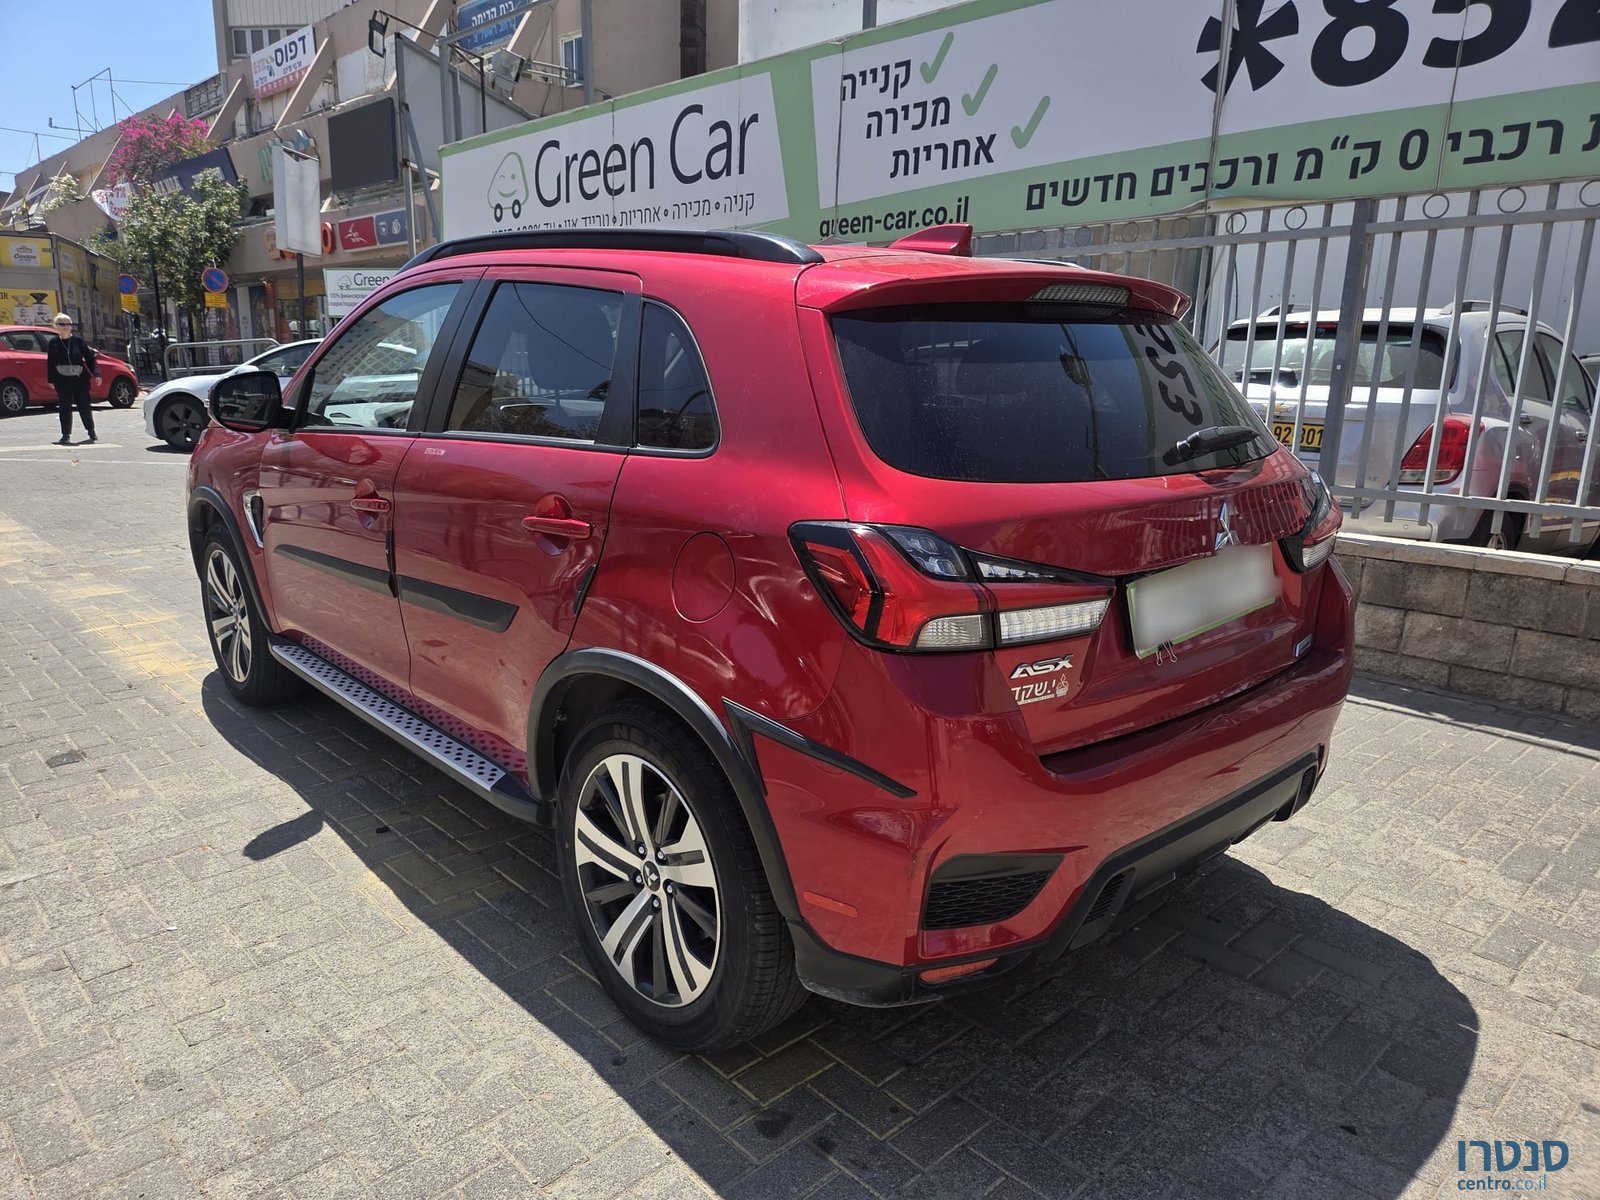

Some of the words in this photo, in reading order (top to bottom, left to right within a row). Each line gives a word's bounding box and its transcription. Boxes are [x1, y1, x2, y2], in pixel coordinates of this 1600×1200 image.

[274, 35, 306, 67] דפוס
[842, 59, 911, 101] קנייה
[866, 96, 951, 139] מכירה
[535, 137, 655, 208] Green
[670, 104, 759, 185] Car
[890, 133, 997, 179] אחריות
[1398, 128, 1430, 171] 0
[1447, 119, 1564, 165] רכבי
[1026, 171, 1137, 211] חדשים
[1150, 152, 1279, 197] ורכבים
[619, 206, 661, 227] אחריות
[672, 199, 711, 220] מכירה
[723, 193, 755, 217] קניה
[820, 196, 969, 241] green-car.co.il
[1010, 654, 1074, 679] ASX
